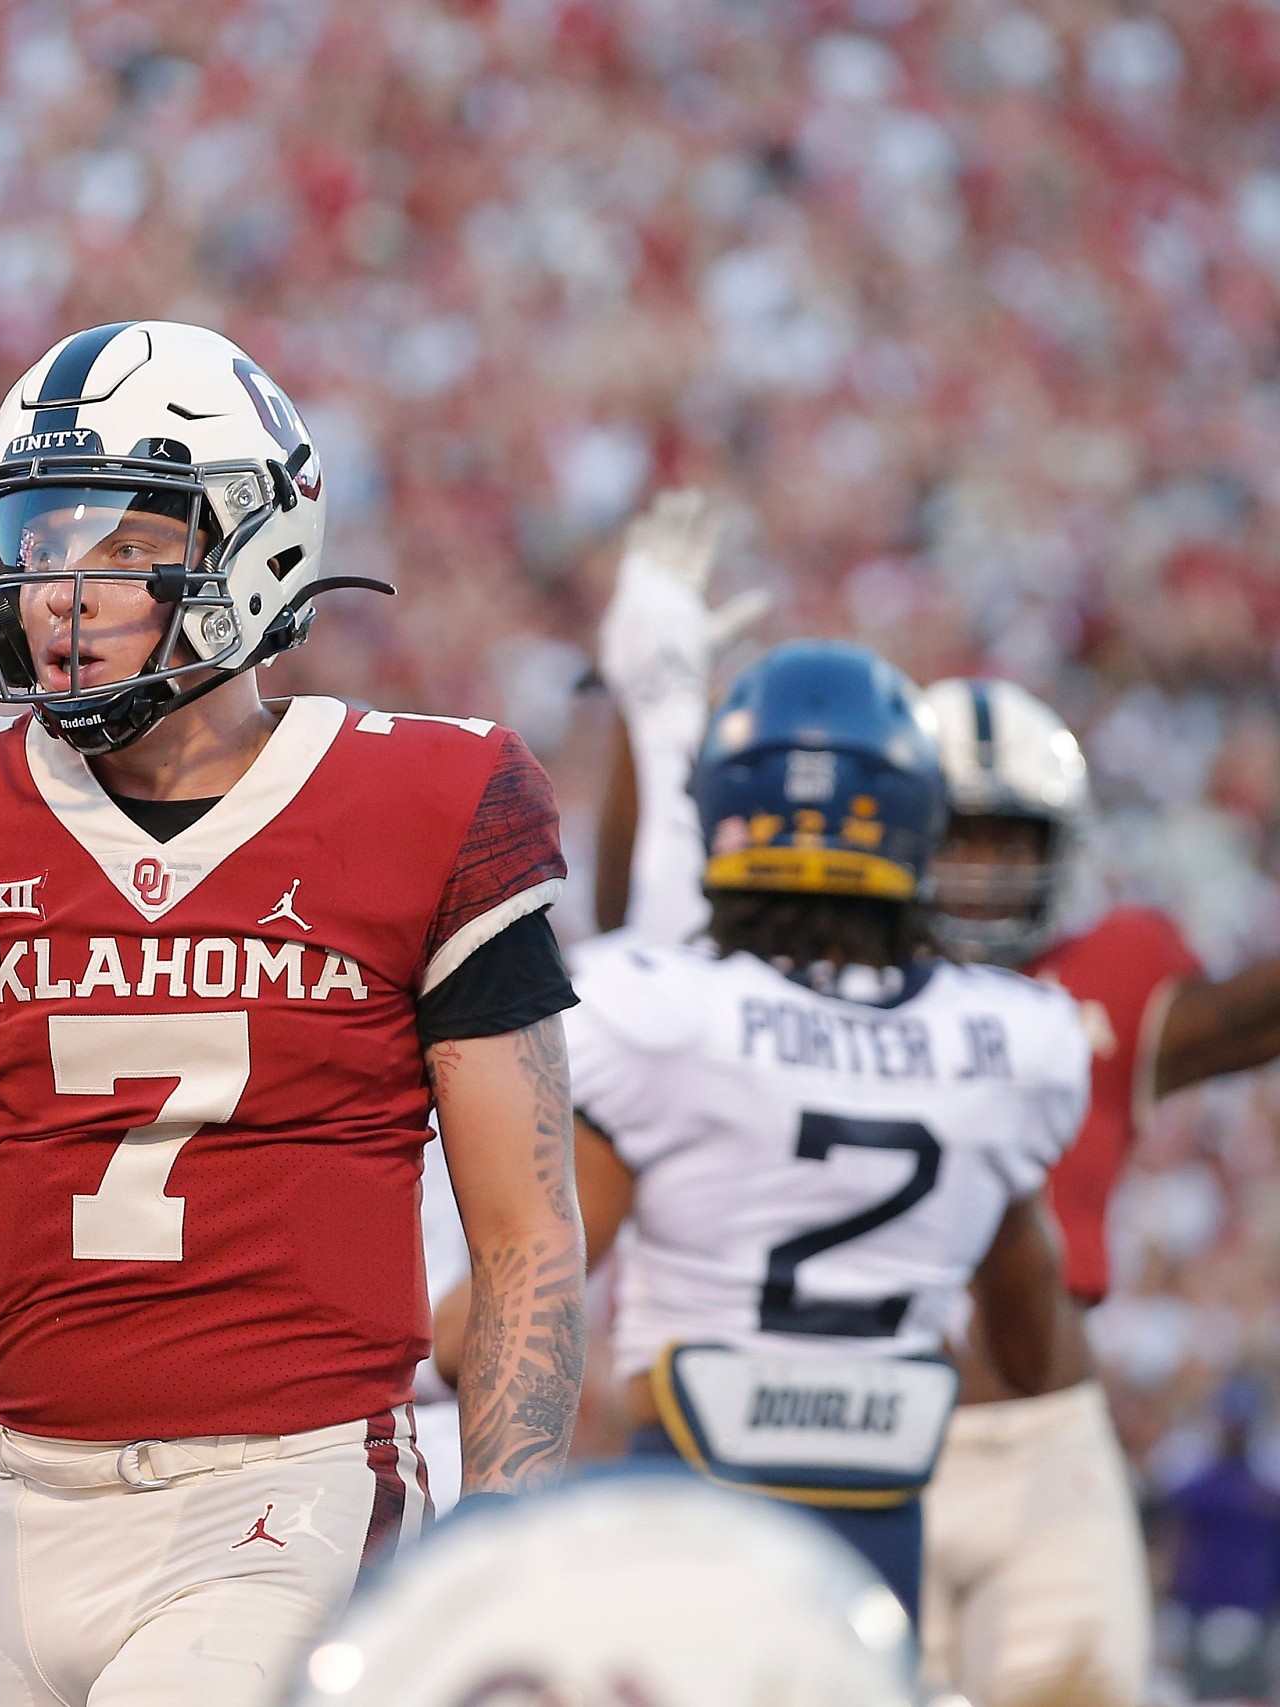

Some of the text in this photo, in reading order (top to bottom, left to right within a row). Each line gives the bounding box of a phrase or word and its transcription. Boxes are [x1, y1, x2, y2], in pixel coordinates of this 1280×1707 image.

[11, 430, 92, 454] UNITY
[130, 855, 173, 909] OU
[741, 995, 937, 1080] PORTER
[956, 1011, 1014, 1080] JR
[47, 1009, 251, 1261] 7
[760, 1111, 941, 1337] 2
[748, 1385, 904, 1433] DOUGLAS
